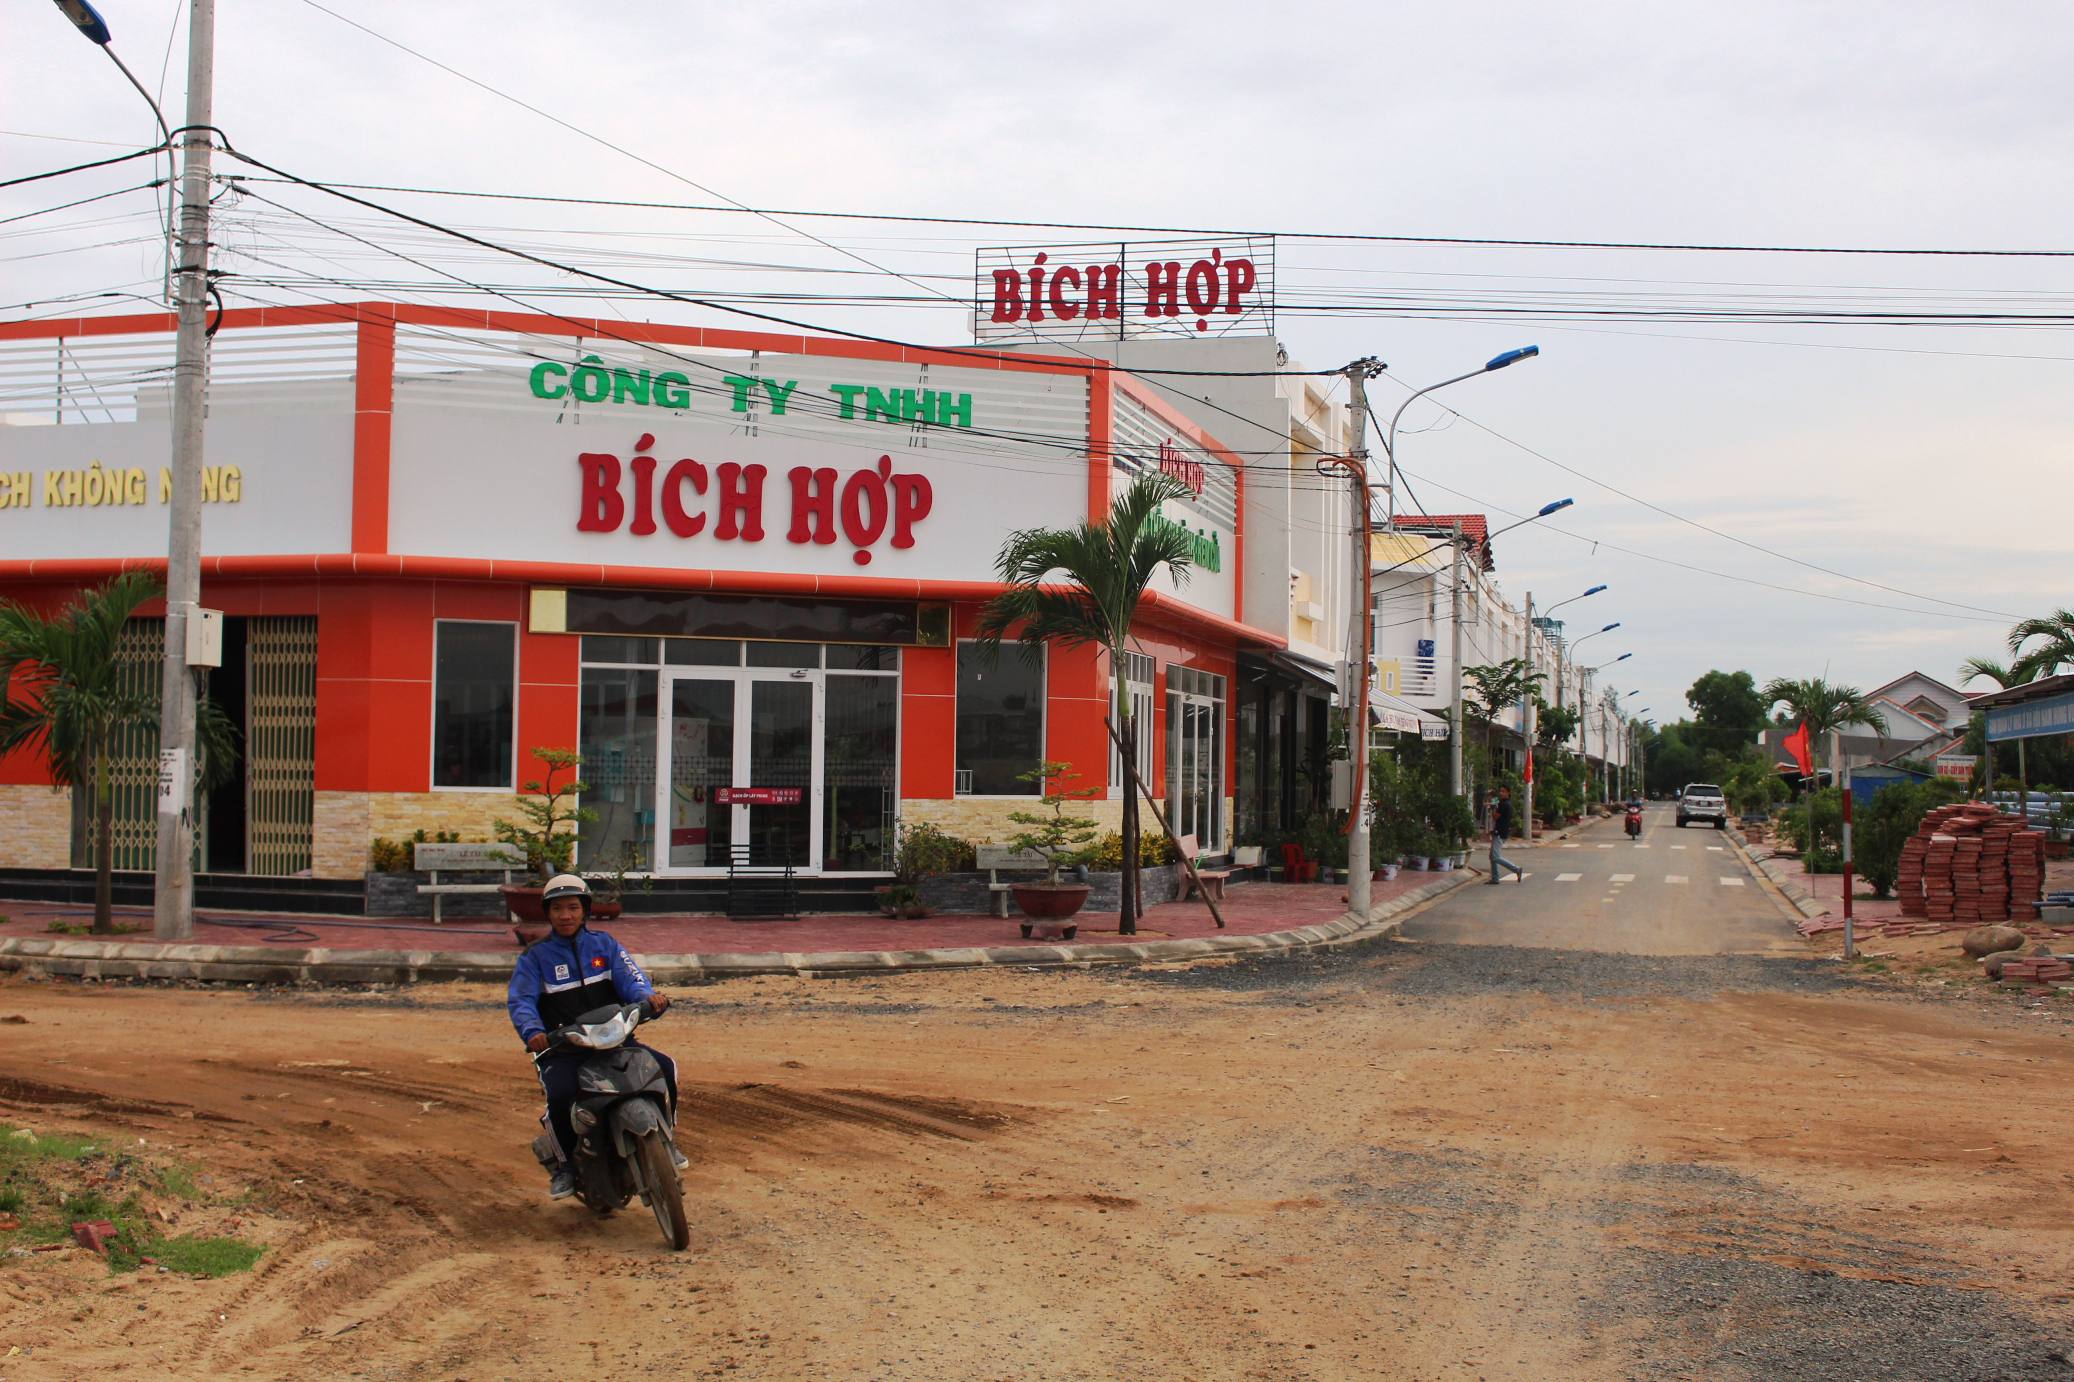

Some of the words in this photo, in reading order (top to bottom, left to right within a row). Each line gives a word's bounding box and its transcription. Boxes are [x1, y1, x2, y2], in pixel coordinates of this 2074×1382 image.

[991, 251, 1122, 323] BÍCH
[1144, 247, 1255, 332] HỢP
[529, 355, 690, 410] CÔNG
[723, 374, 798, 415] TY
[830, 383, 972, 427] TNHH
[44, 460, 147, 507] KHÔNG
[158, 464, 241, 504] NNG
[576, 433, 768, 542] BÍCH
[786, 454, 933, 566] HỢP
[159, 784, 171, 797] 04
[620, 950, 645, 985] SUZUKI
